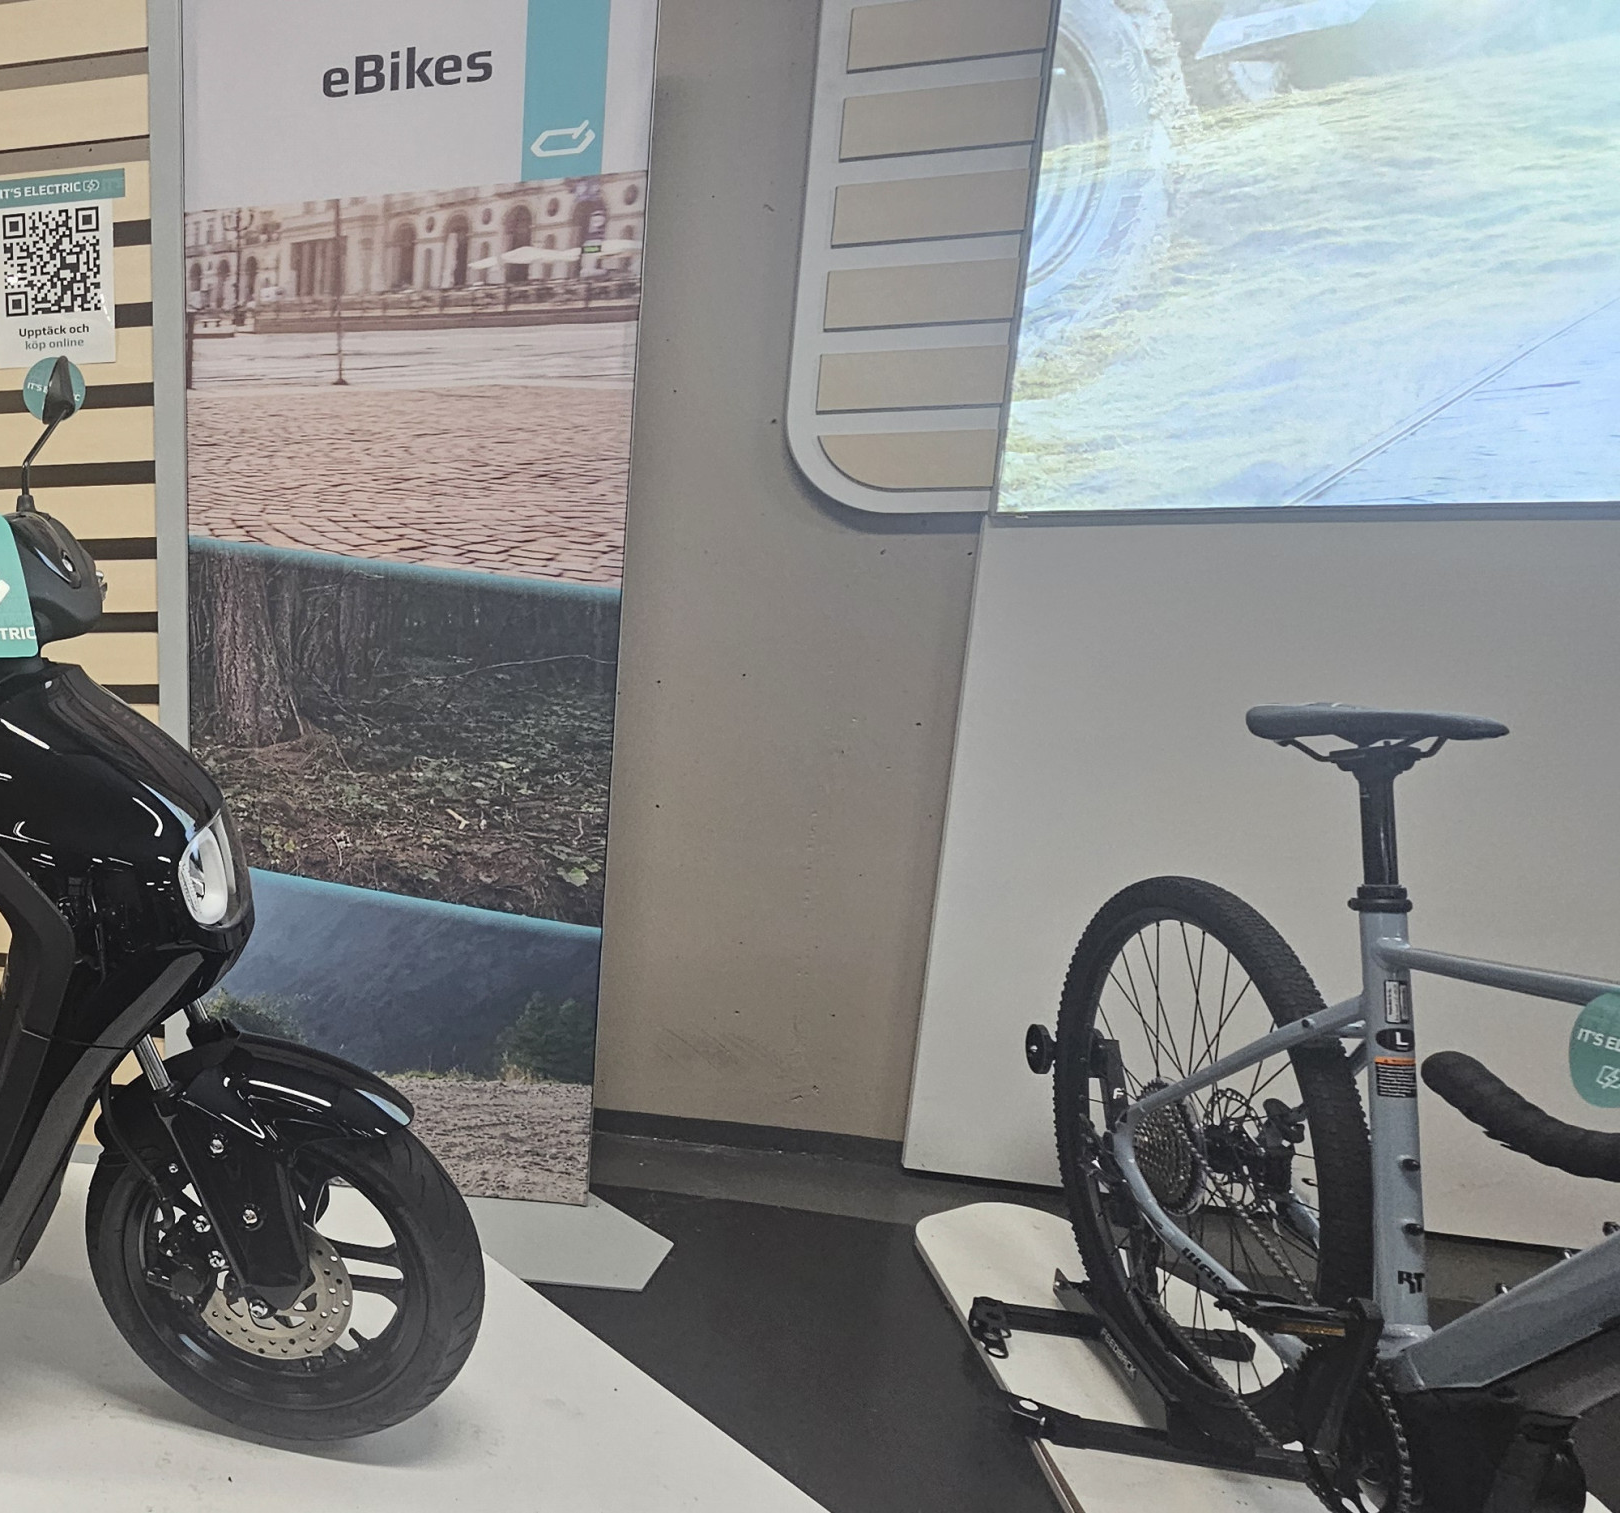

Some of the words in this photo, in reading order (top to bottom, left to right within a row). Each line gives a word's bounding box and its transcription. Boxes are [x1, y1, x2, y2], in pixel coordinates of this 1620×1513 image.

[322, 46, 493, 98] eBikes
[0, 187, 22, 200] IT'S
[24, 181, 82, 197] ELECTRIC
[18, 325, 67, 339] Upptäck
[69, 323, 90, 334] och
[25, 340, 46, 351] köp
[48, 338, 85, 349] online
[1395, 1031, 1409, 1046] L
[1577, 1027, 1605, 1047] IT'S
[1397, 1270, 1426, 1295] RT
